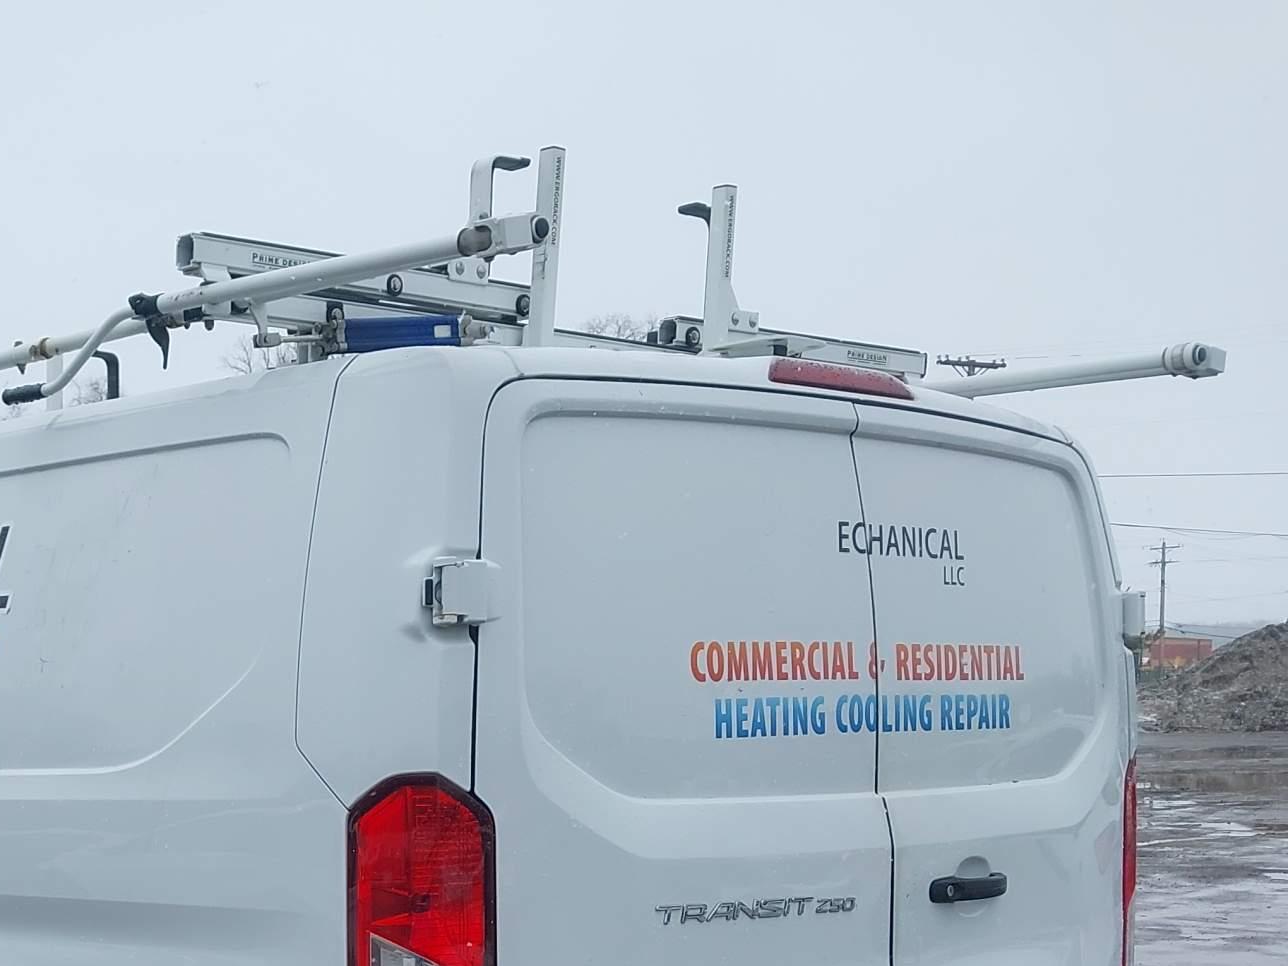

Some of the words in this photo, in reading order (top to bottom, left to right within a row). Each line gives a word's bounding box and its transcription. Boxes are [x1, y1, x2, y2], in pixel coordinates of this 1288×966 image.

[838, 521, 965, 560] ECHANICAL
[943, 565, 965, 586] LLC
[689, 641, 859, 682] COMMERCIAL
[895, 643, 1025, 681] RESIDENTIAL
[714, 695, 826, 739] HEATING
[835, 694, 933, 733] COOLING
[940, 693, 1011, 731] REPAIR
[655, 896, 815, 925] TRANSIT
[815, 897, 856, 914] 250
